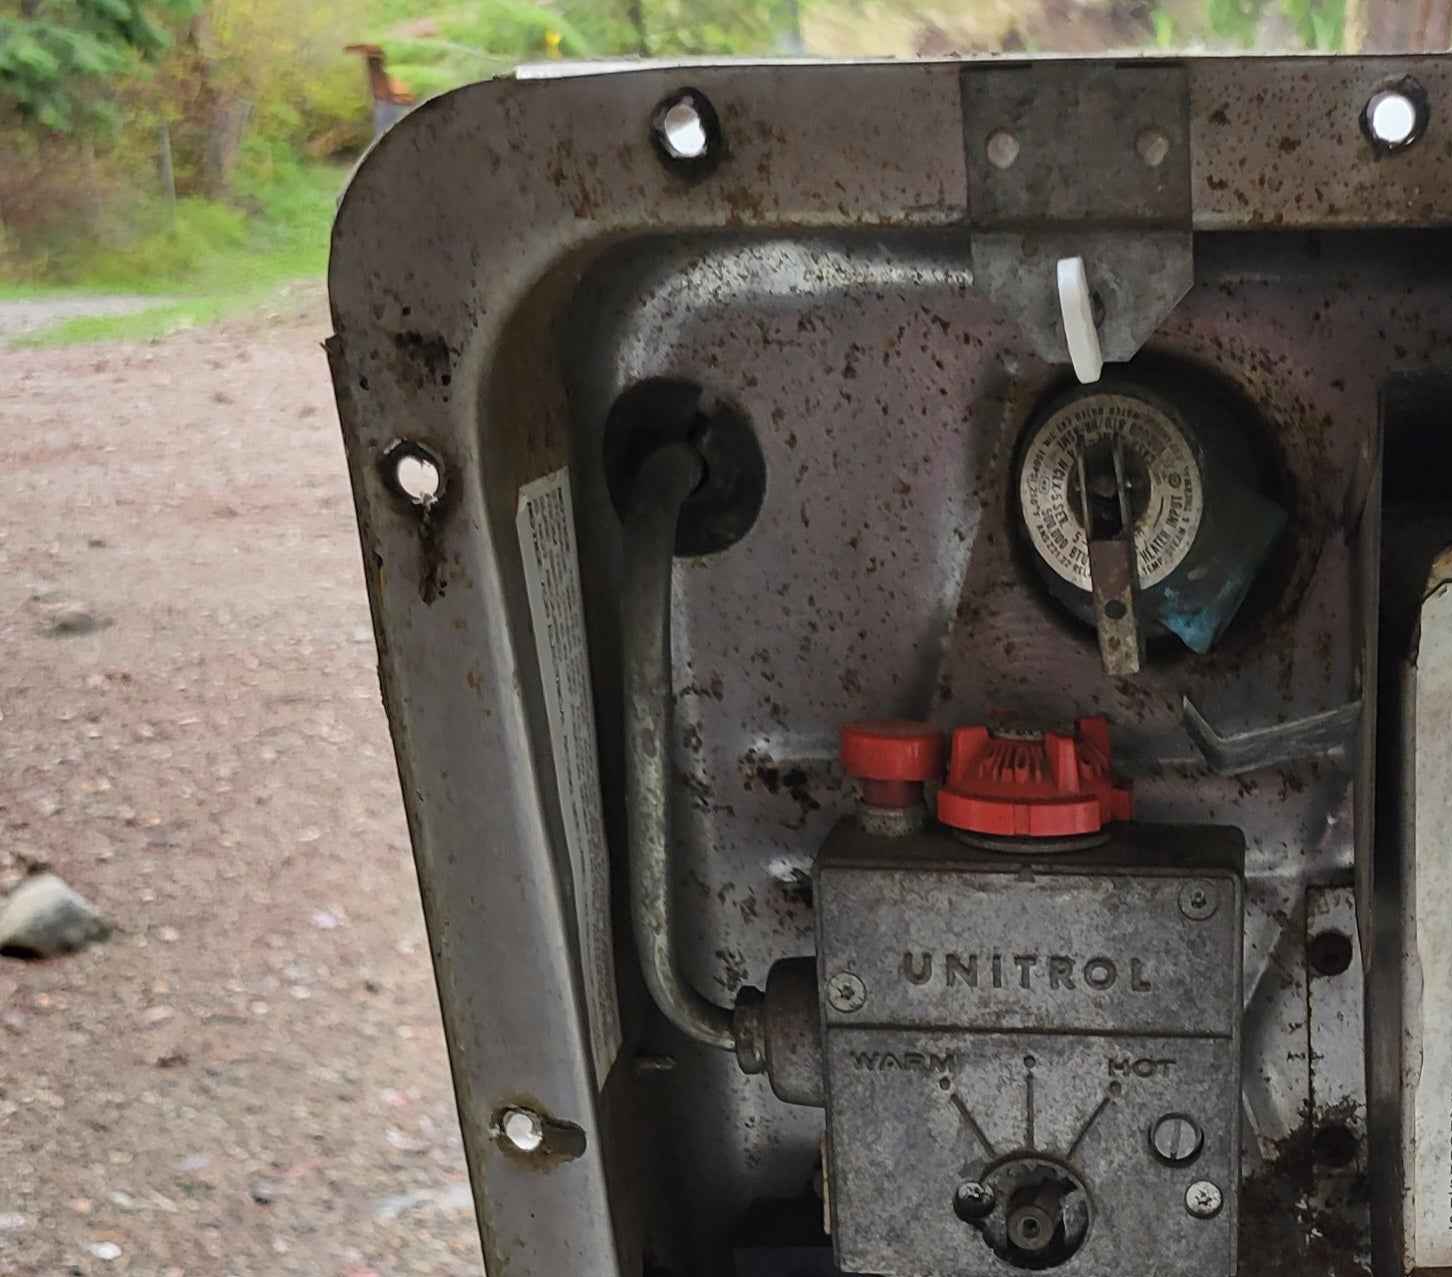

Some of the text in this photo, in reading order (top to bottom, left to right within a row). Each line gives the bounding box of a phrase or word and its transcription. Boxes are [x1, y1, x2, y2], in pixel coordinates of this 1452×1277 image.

[902, 951, 1153, 993] UNITROL
[850, 1049, 1178, 1080] WARM HOT
